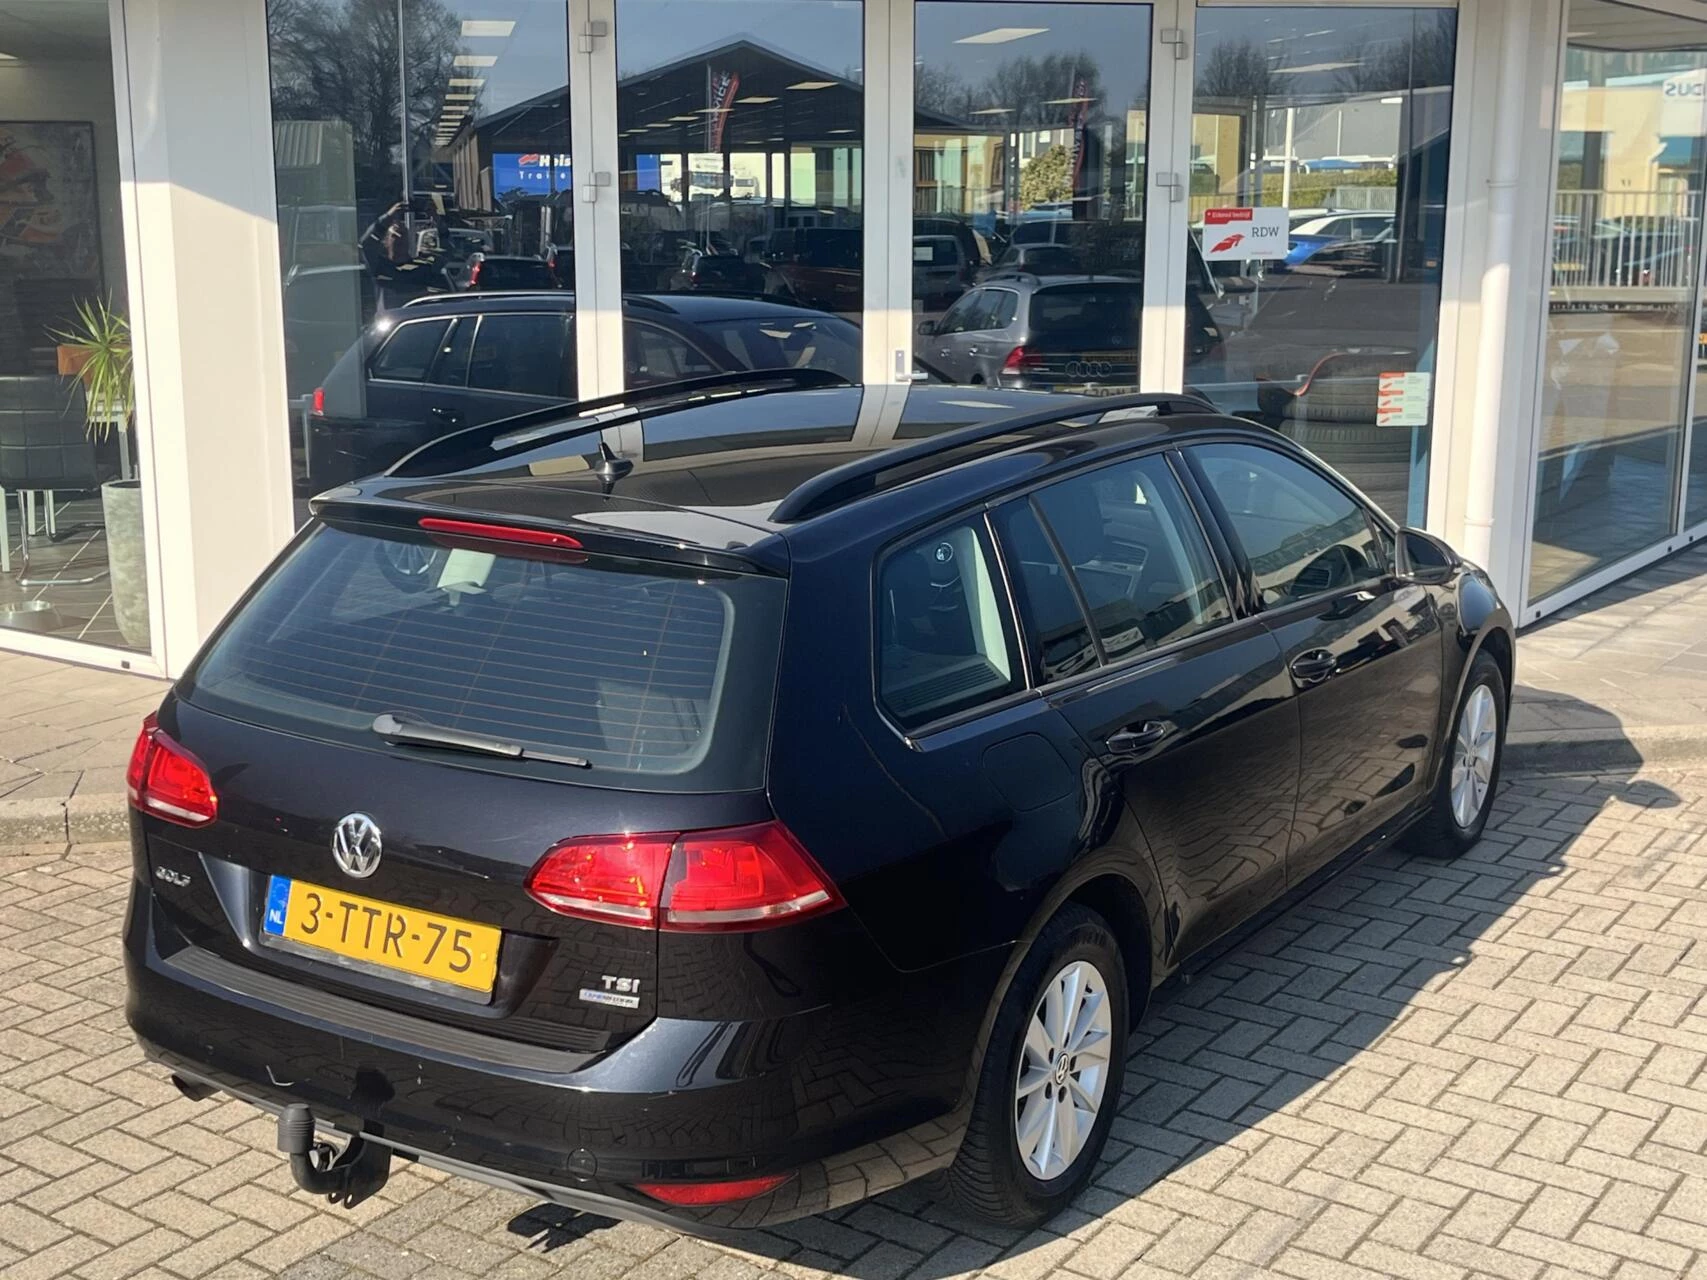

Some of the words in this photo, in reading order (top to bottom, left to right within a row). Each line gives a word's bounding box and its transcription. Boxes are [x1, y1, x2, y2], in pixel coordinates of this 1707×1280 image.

[1251, 226, 1280, 238] RDW
[155, 866, 191, 887] GOLF
[268, 909, 284, 925] NL
[300, 892, 473, 973] 3-TTR-75
[601, 975, 641, 993] TSI
